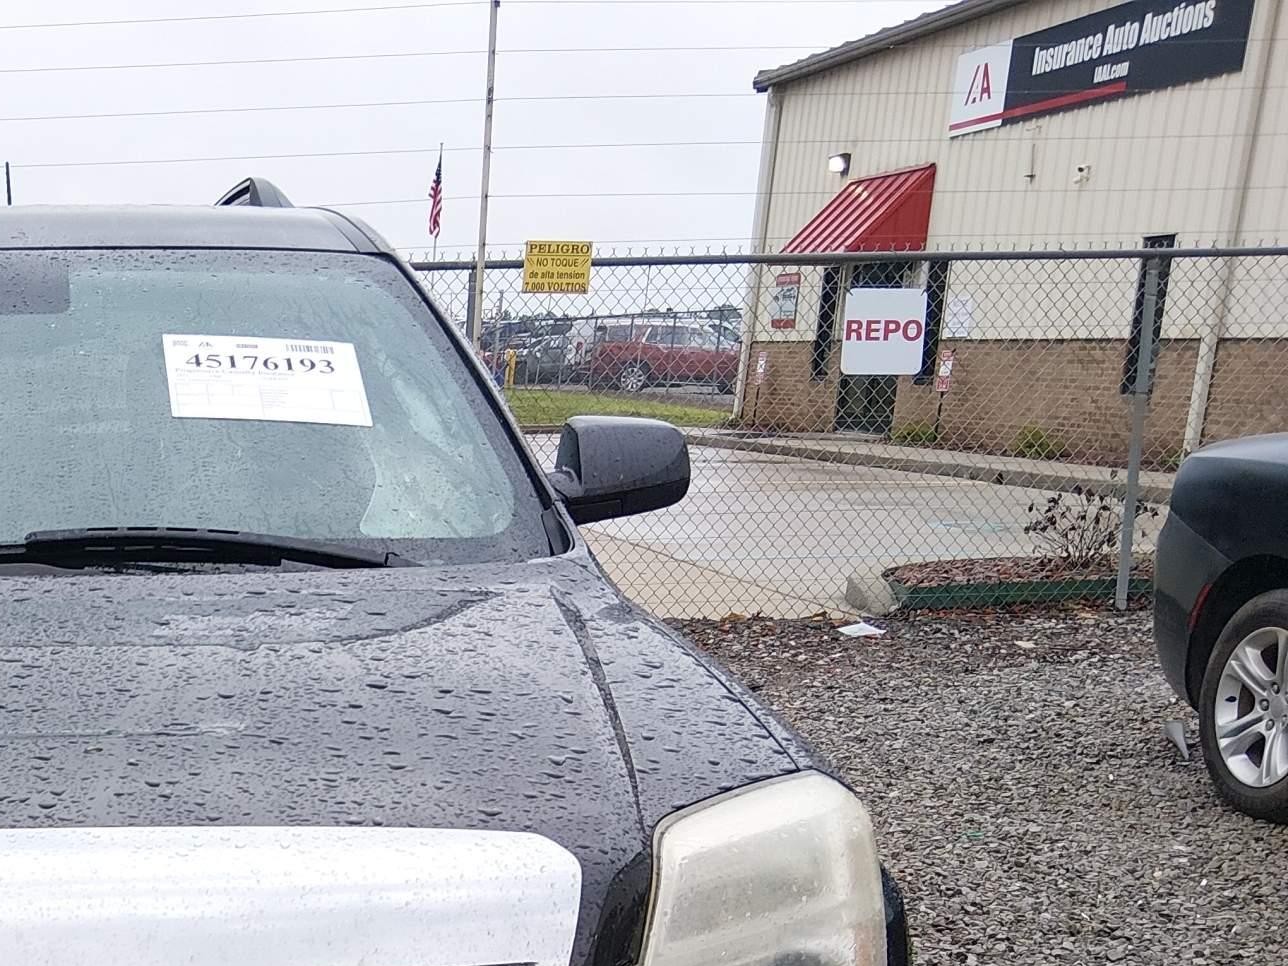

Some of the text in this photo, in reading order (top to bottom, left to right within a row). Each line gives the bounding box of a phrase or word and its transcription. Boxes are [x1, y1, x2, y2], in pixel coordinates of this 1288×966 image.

[1031, 0, 1217, 76] Insurance Auto Auctions
[528, 243, 590, 254] PELIGRO
[536, 257, 579, 267] NO TOQUE
[529, 270, 539, 279] de
[541, 270, 554, 280] alta
[548, 282, 586, 292] VOLTIOS
[845, 319, 923, 342] REPO
[185, 353, 335, 374] 45176193
